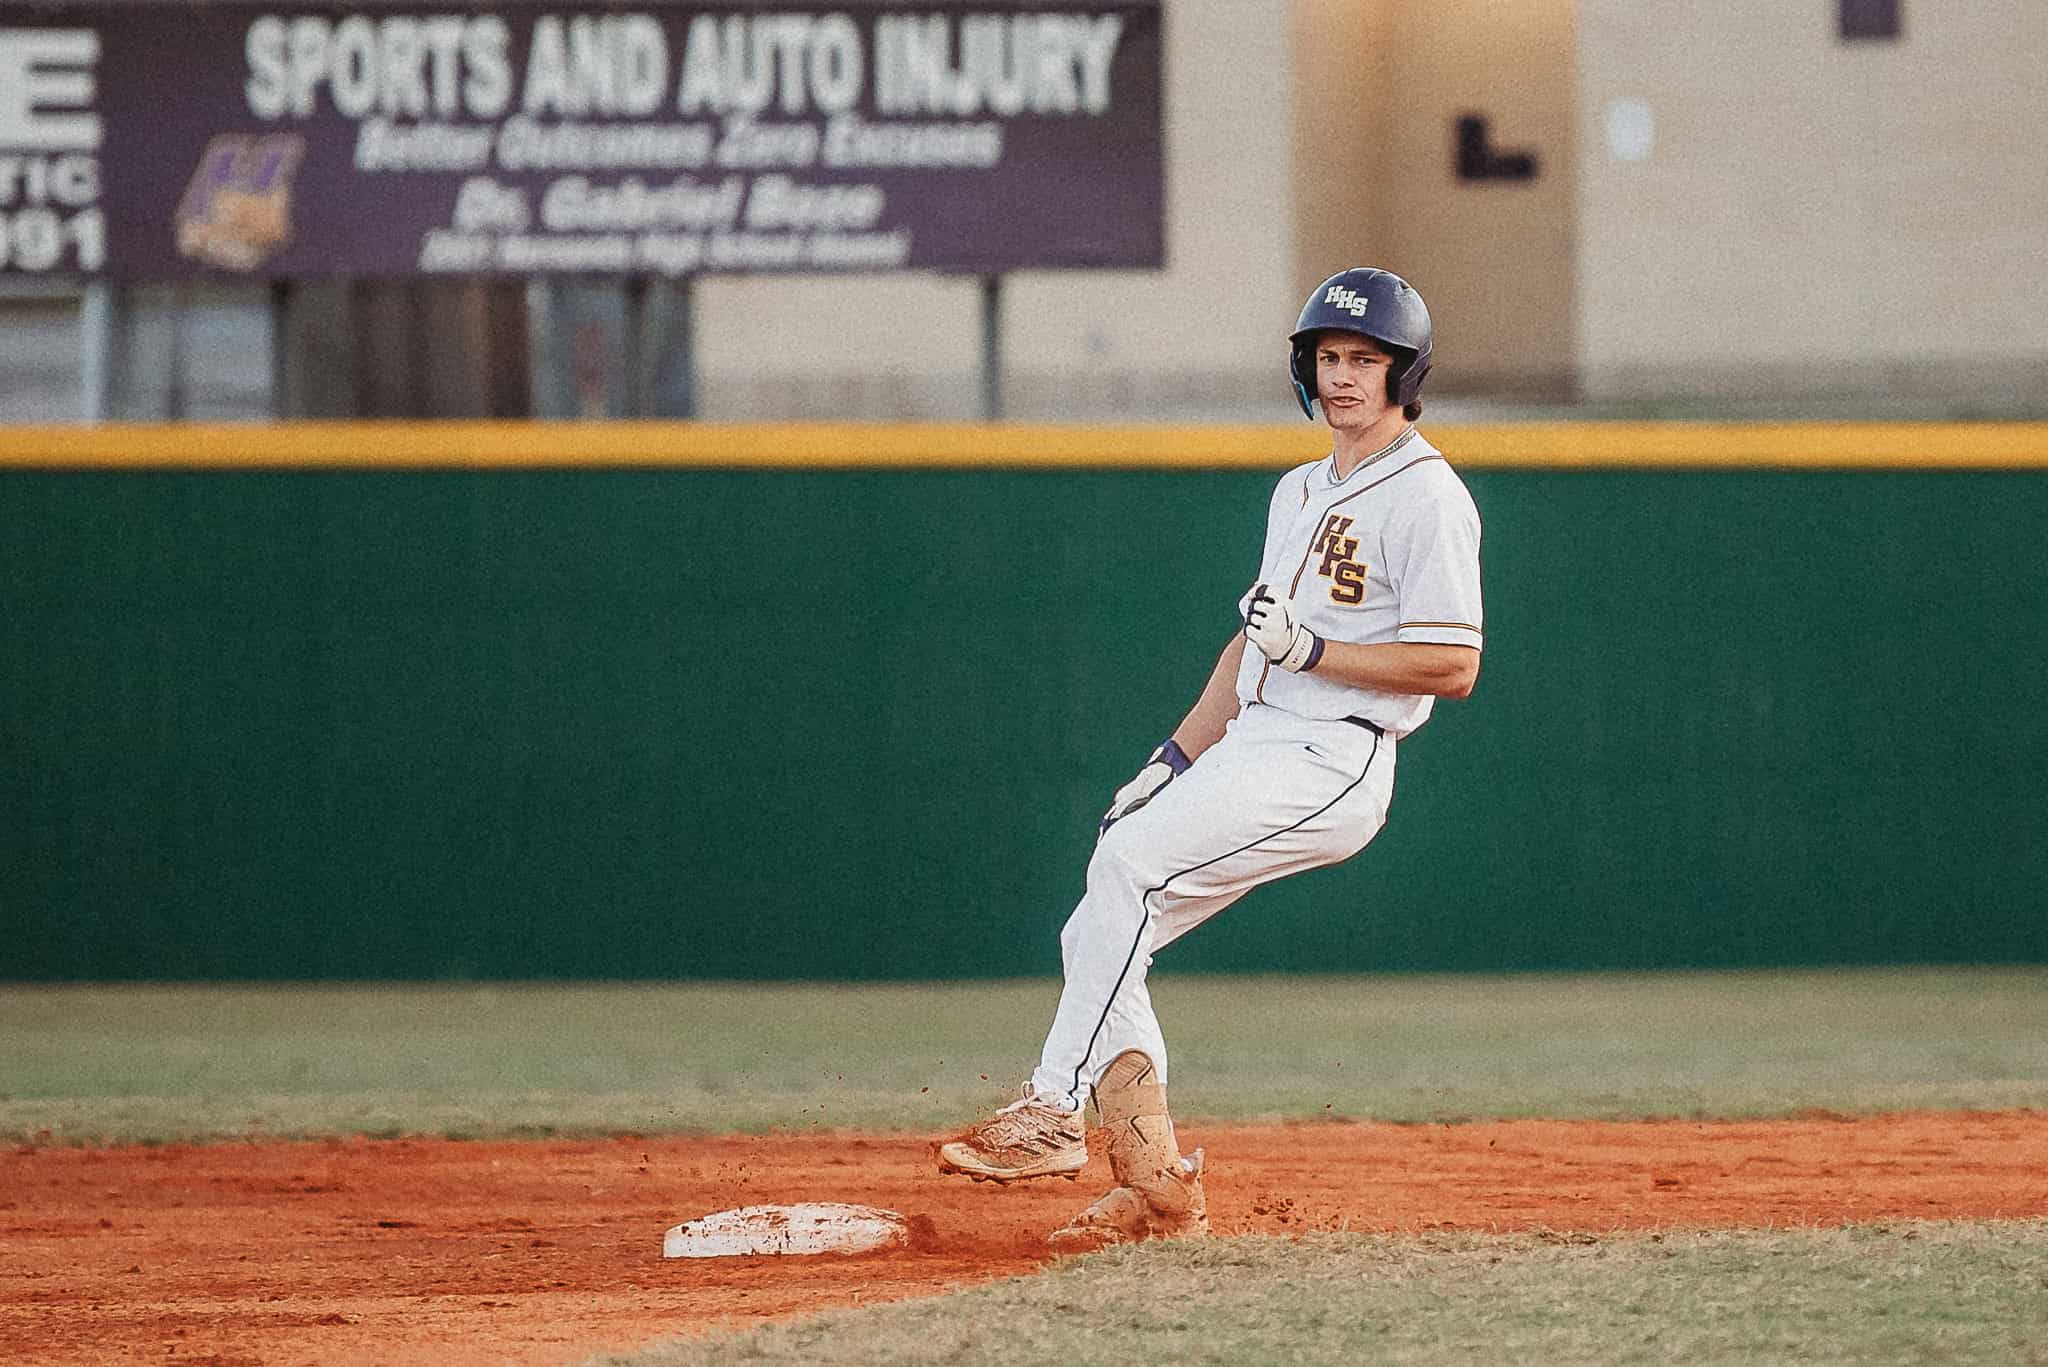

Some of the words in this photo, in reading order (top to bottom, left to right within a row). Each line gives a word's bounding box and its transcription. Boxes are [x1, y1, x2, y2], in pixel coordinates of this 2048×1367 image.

[246, 15, 511, 118] SPORTS
[523, 15, 669, 116] AND
[681, 14, 861, 114] AUTO
[874, 14, 1123, 114] INJURY
[1325, 285, 1368, 317] HHS
[1313, 514, 1368, 605] HHS
